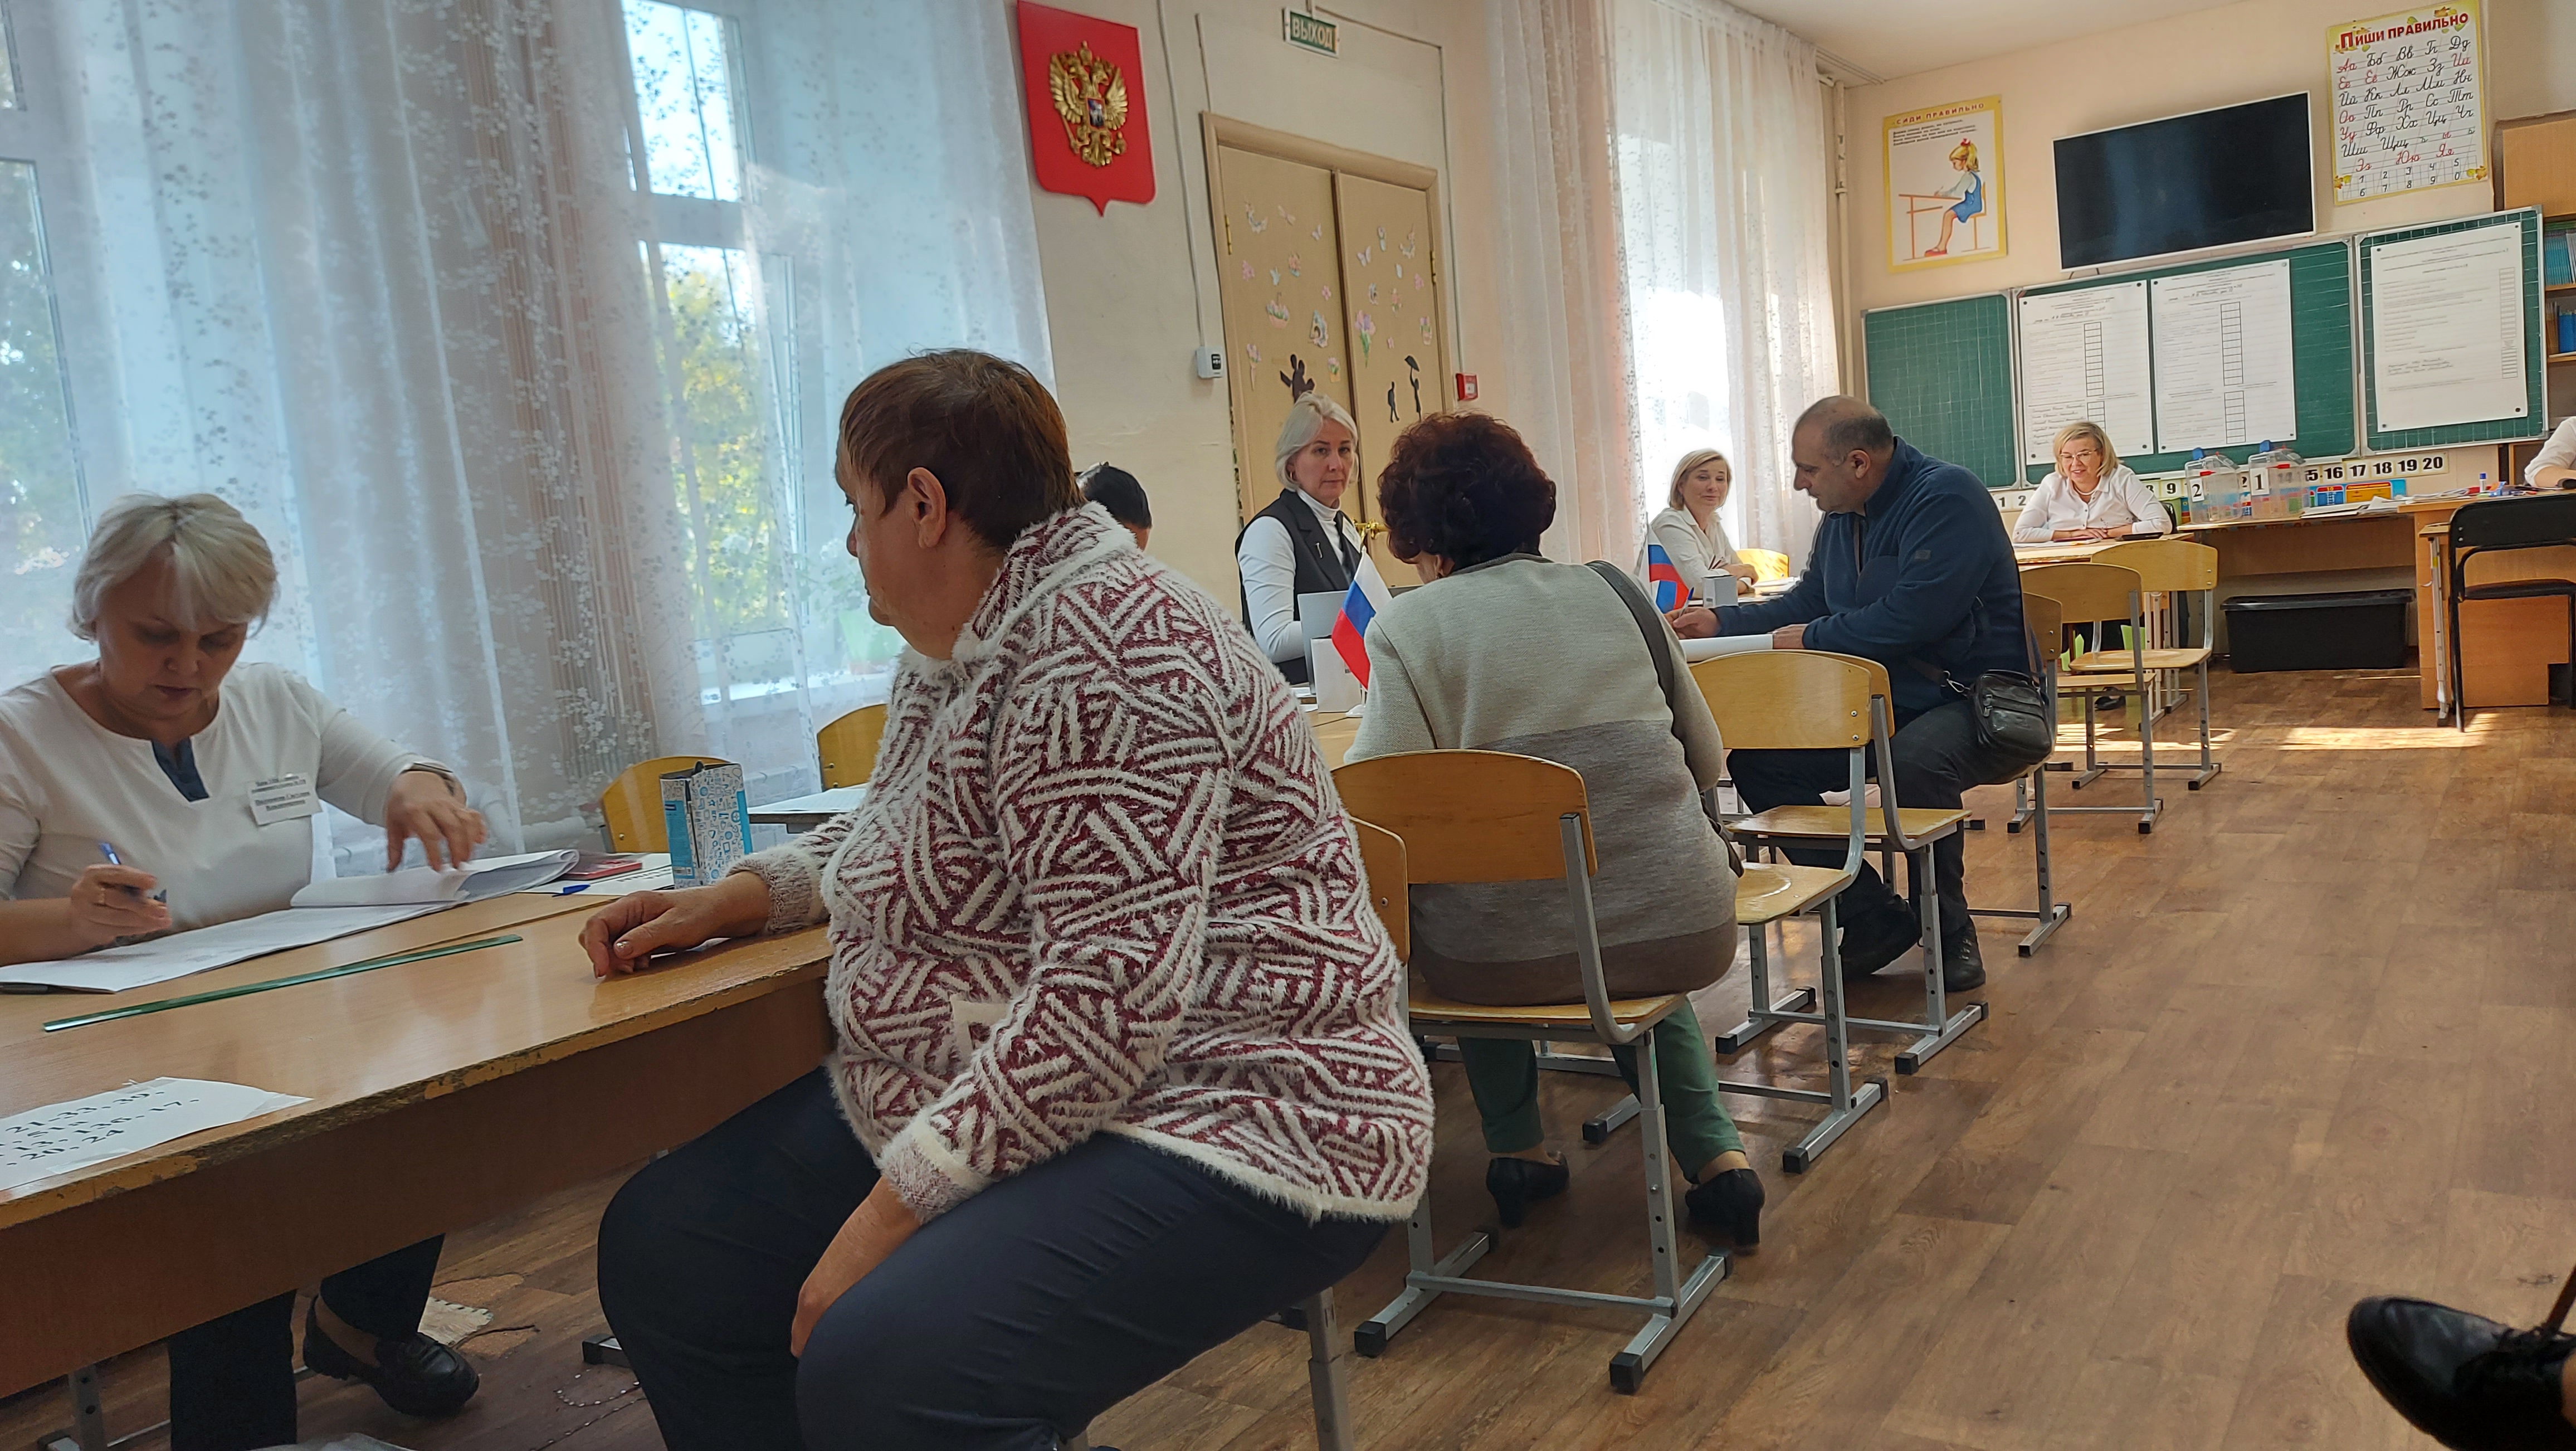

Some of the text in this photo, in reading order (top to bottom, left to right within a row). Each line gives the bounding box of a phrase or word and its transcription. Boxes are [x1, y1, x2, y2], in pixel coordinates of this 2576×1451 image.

[1292, 17, 1333, 50] ВЫХОД
[2336, 36, 2470, 73] Аа Бб Вв Гг Дд
[2339, 77, 2350, 89] Ее
[2387, 65, 2416, 80] Жж
[2427, 59, 2445, 75] Зз
[2452, 54, 2471, 66] Ии
[2339, 70, 2472, 106] Йй Кк Лл Мм Нн
[1896, 103, 1984, 125] СИДИ ПРАВИЛЬНО
[2339, 87, 2473, 124] Оо Пп Рр Сс Тт
[2340, 106, 2473, 143] Уу Фф Хх Цц Чч
[2341, 144, 2368, 157] Шш
[2380, 137, 2409, 151] Щщ
[2356, 144, 2454, 172] Ээ Юю Яя
[1999, 497, 2006, 507] 1
[2018, 495, 2026, 506] 2
[2167, 483, 2176, 494] 9
[2324, 467, 2343, 479] 16
[2350, 464, 2366, 477] 17
[2374, 462, 2392, 474] 18
[2398, 459, 2417, 472] 19
[2423, 456, 2443, 470] 20
[2192, 484, 2202, 497] 2
[2255, 474, 2264, 490] 1
[82, 1129, 124, 1143] 24
